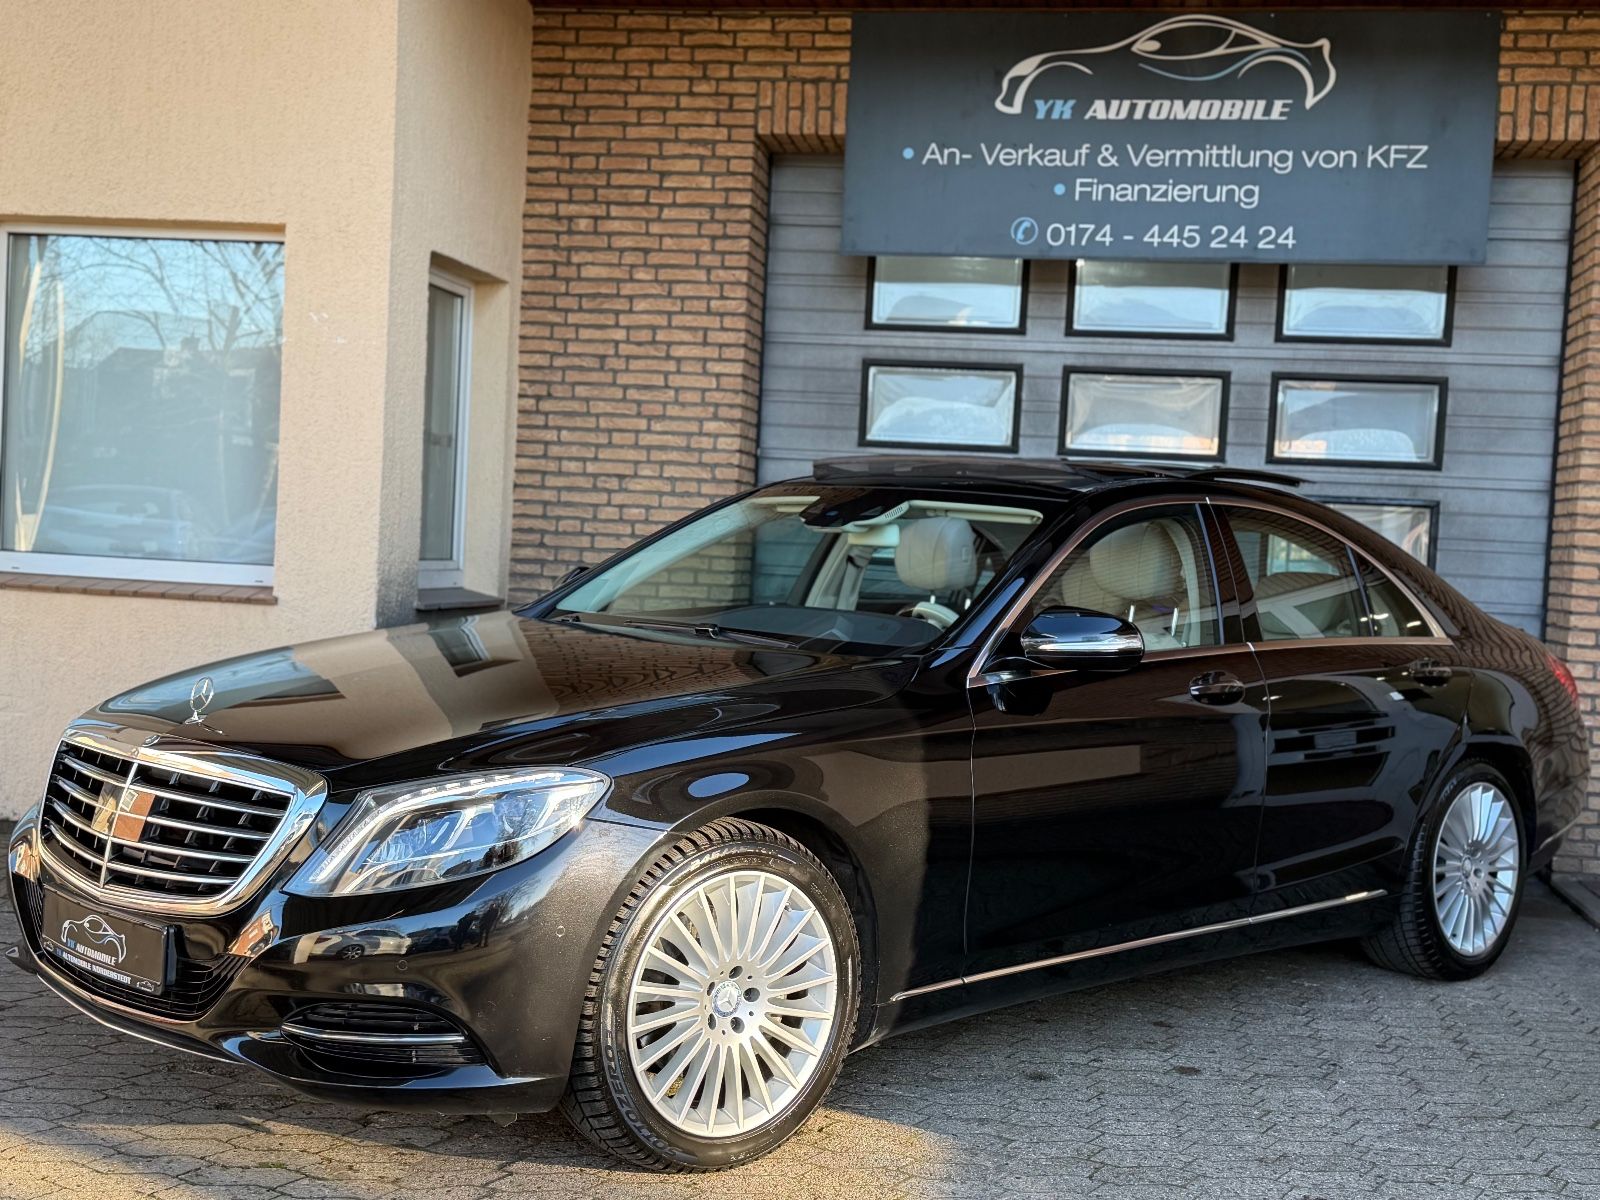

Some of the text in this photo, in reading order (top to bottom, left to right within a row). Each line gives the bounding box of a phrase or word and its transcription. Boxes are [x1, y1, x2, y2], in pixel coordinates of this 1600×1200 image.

[1033, 99, 1293, 121] YK AUTOMOBILE
[922, 143, 1429, 175] An- Verkauf & Vermittlung von KFZ
[1074, 178, 1261, 208] Finanzierung
[1046, 223, 1114, 247] 0174
[1142, 224, 1201, 248] 445
[1209, 225, 1250, 249] 24
[1257, 225, 1297, 249] 24
[62, 952, 92, 970] AUTOMOBILE
[92, 964, 132, 985] NORDERSTEDT
[75, 943, 117, 966] AUTOMOBILE
